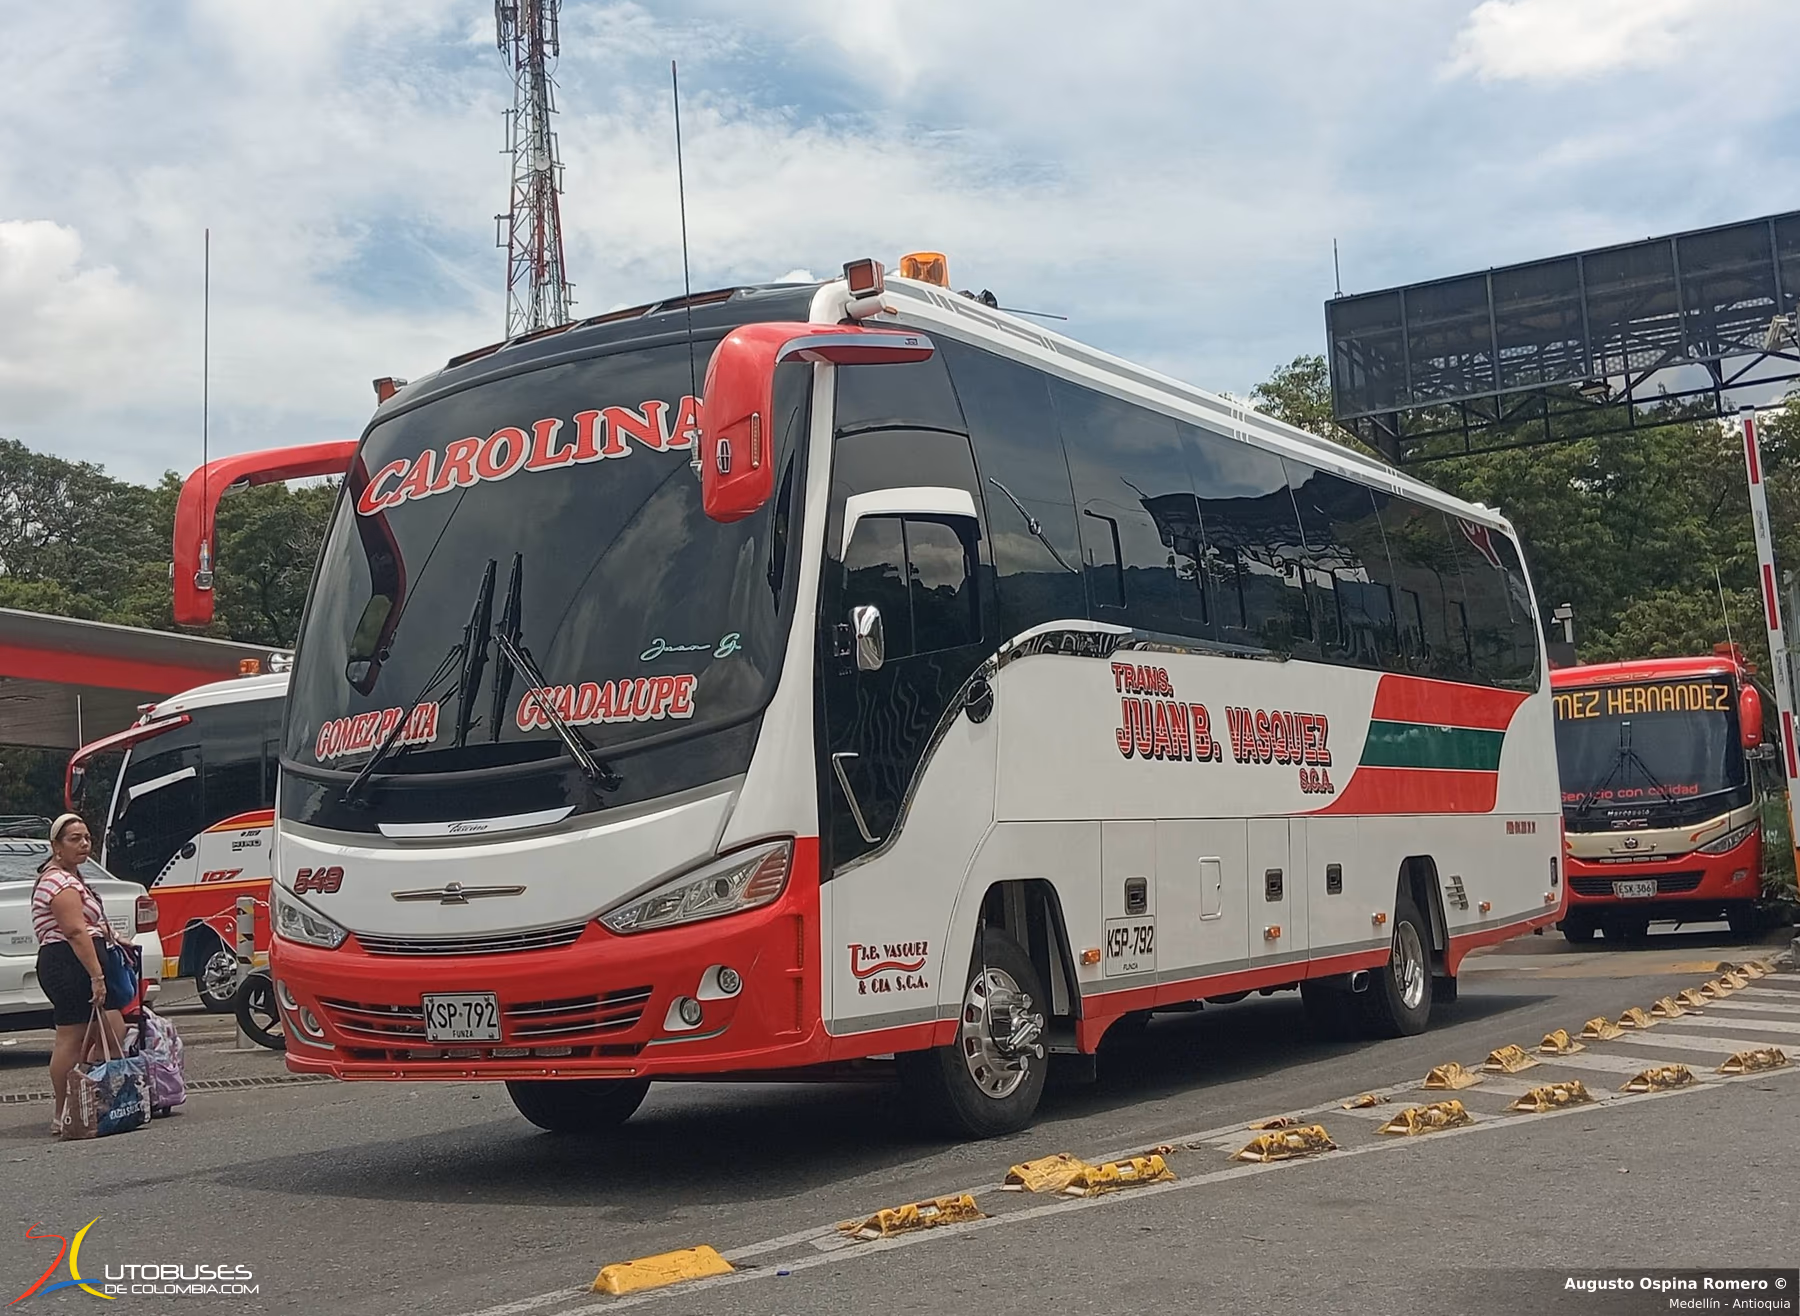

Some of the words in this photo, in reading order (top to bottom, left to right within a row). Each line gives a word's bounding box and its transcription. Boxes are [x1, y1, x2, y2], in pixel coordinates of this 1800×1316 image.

[357, 396, 704, 516] CAROLINA
[640, 638, 711, 661] Juan
[1111, 662, 1175, 698] TRANS.
[515, 674, 698, 732] GUADALUPE
[1606, 684, 1731, 716] HERNANDEZ
[315, 710, 381, 763] GOMEZ
[375, 701, 440, 750] PLATA
[1116, 696, 1192, 761] JUAN
[1189, 703, 1223, 763] B.
[1225, 706, 1333, 768] VASQUEZ
[1300, 768, 1335, 794] S.C.A.
[1618, 788, 1643, 797] con
[293, 865, 345, 895] 549
[883, 941, 928, 958] VASQUEZ
[1106, 925, 1154, 958] KSP-792
[871, 978, 891, 993] CIA
[896, 975, 928, 991] S.C.A.
[452, 1030, 474, 1038] FUNZA
